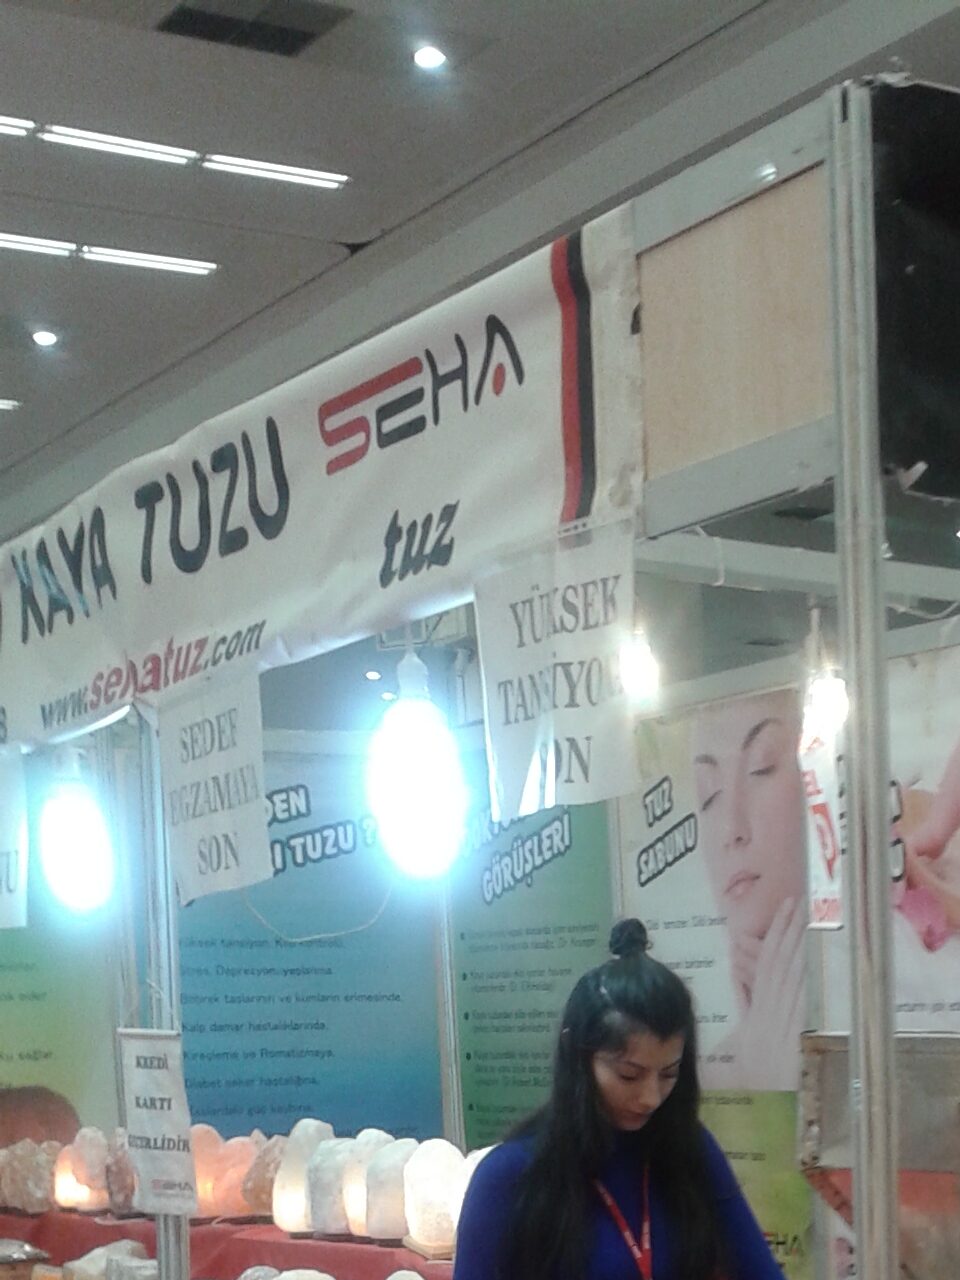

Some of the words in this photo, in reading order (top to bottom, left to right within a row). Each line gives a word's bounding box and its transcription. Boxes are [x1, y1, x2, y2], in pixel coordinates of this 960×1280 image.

[318, 314, 524, 475] SEHA
[10, 505, 117, 645] KAYA
[134, 416, 290, 585] TUZU
[379, 500, 460, 588] tuz
[508, 573, 622, 649] YÜKSEK
[40, 619, 266, 730] www.sehatuz.com
[179, 707, 239, 765] SEDEF
[643, 775, 674, 828] TUZ
[197, 831, 242, 876] SON
[287, 820, 358, 869] TUZU
[637, 812, 698, 888] SABUNU
